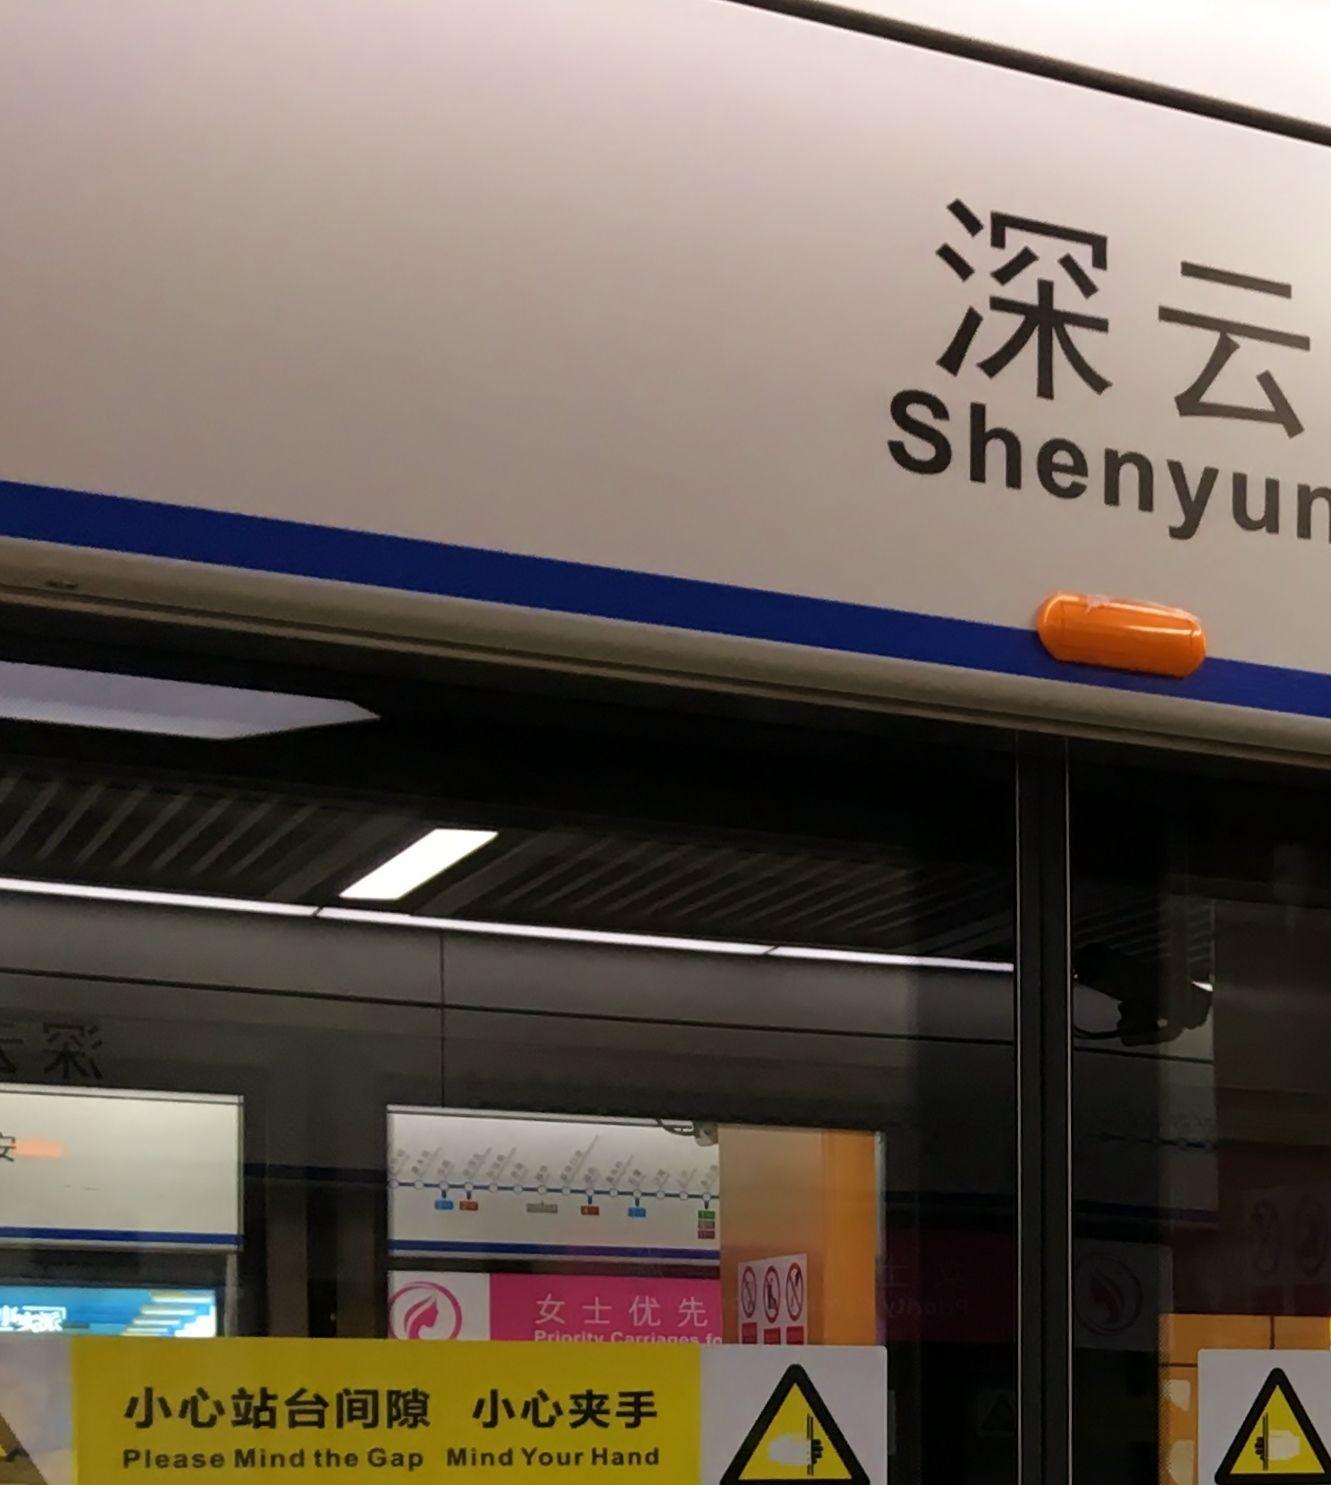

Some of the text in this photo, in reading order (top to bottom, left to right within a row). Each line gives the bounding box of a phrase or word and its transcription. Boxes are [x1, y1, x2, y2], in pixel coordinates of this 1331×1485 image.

[935, 198, 1310, 439] 深云
[535, 1293, 708, 1327] 女士优先
[534, 1330, 604, 1343] Priority
[705, 1333, 722, 1345] fo
[124, 1387, 658, 1429] 小心站台间隙 小心夹手
[123, 1447, 659, 1471] Please Mind the Gap Mind Your Hand
